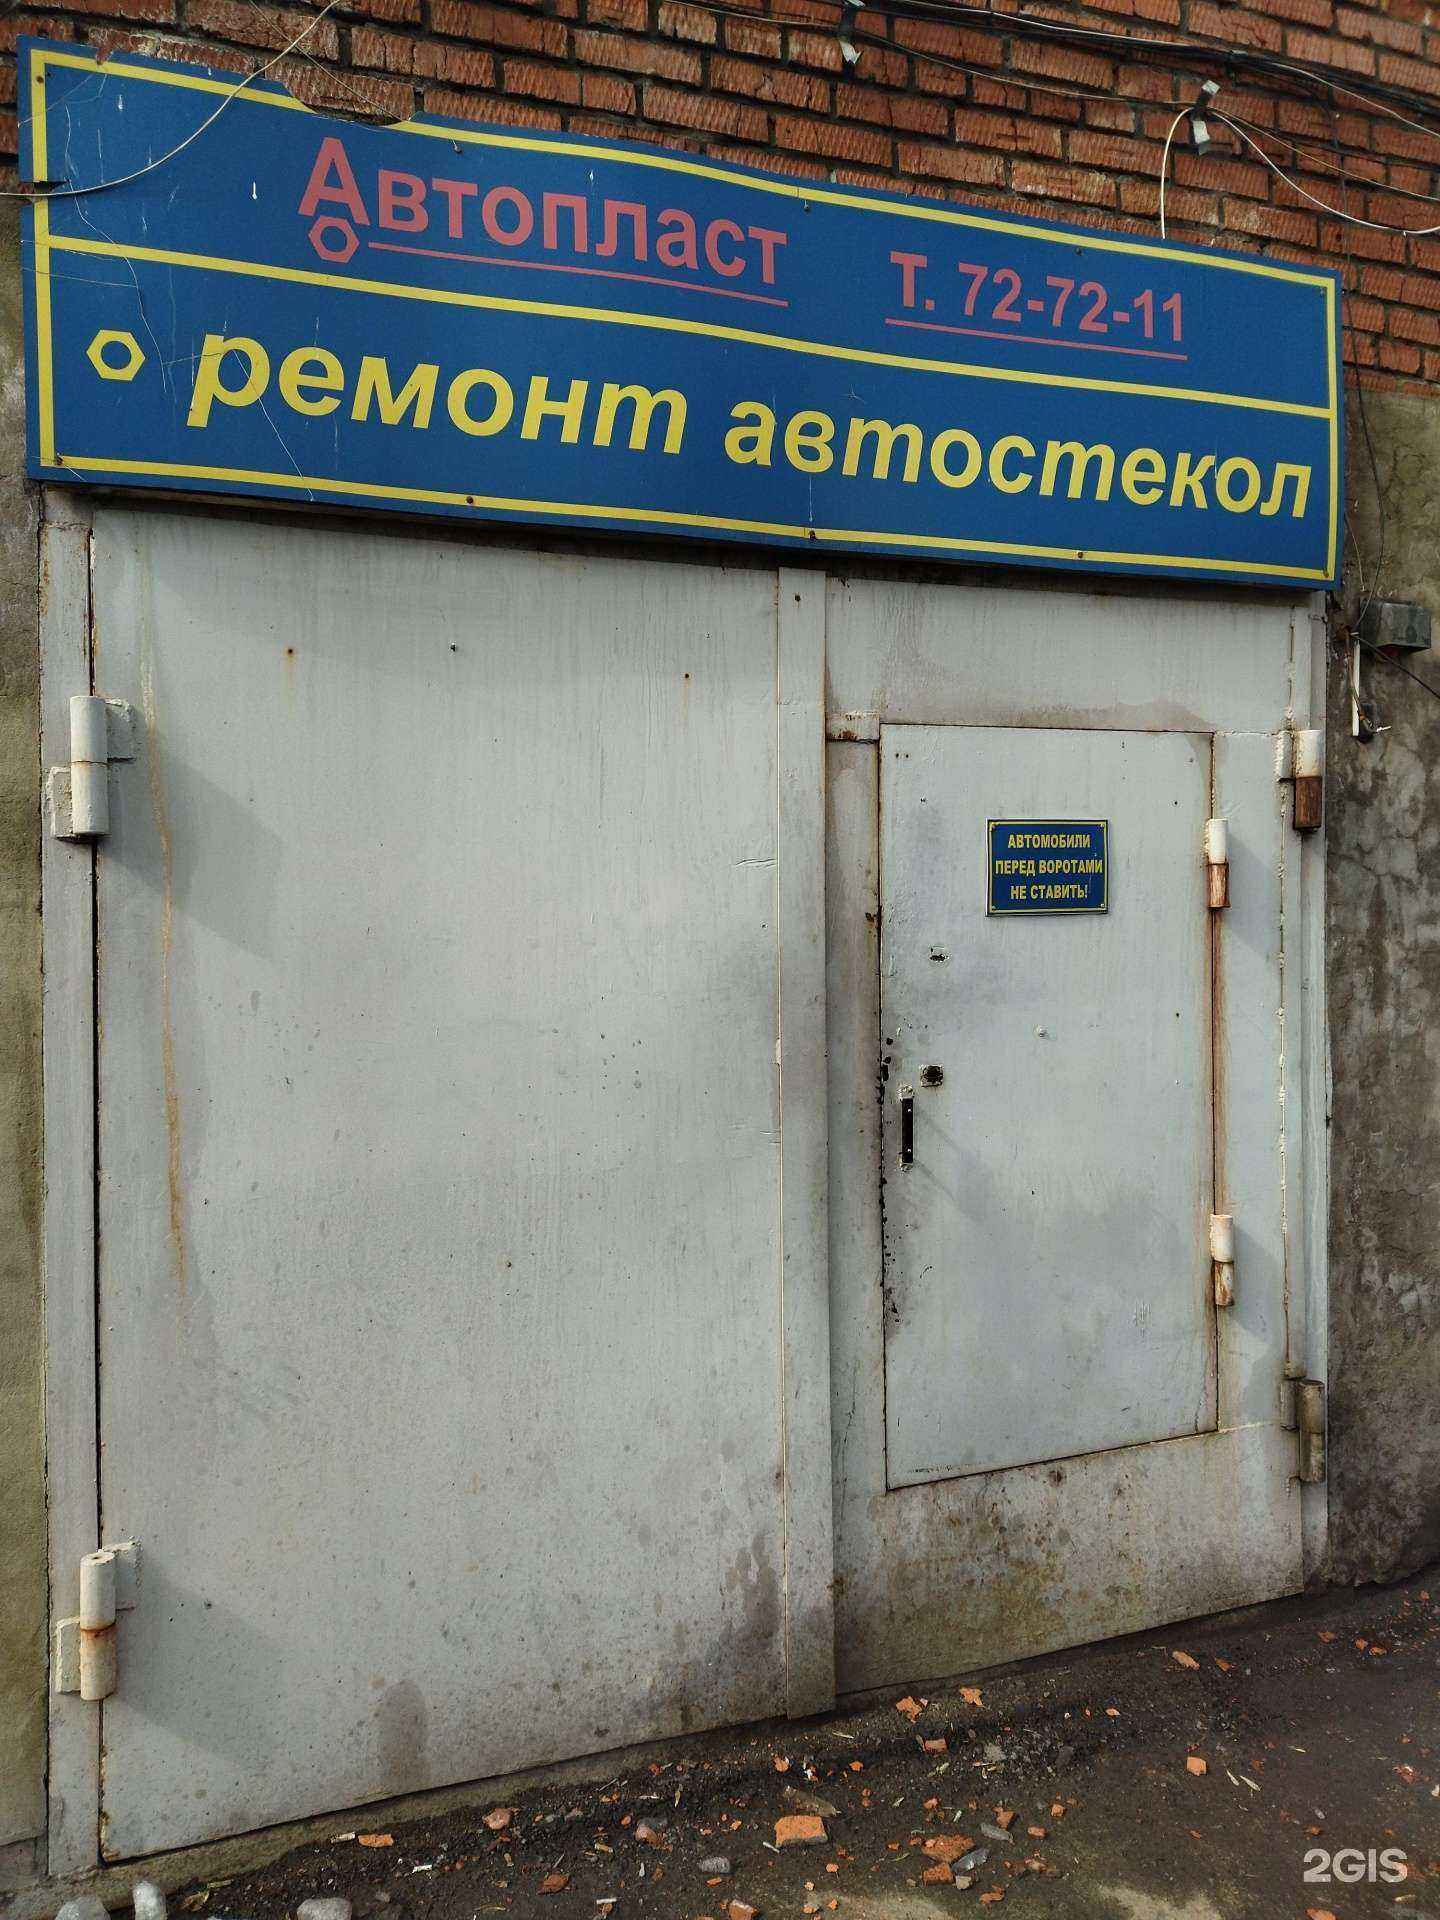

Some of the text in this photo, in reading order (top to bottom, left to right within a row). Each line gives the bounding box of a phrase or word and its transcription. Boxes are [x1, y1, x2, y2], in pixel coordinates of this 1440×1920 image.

[299, 137, 788, 285] Автопласт
[958, 262, 1184, 342] 72-72-11
[186, 333, 1312, 519] ремонт автостекол
[1008, 834, 1091, 848] АВТОМОБИЛИ
[995, 859, 1103, 876] ПЕРЕД ВОРОТАМИ
[1011, 884, 1088, 900] НЕ СТАВИТЬ!
